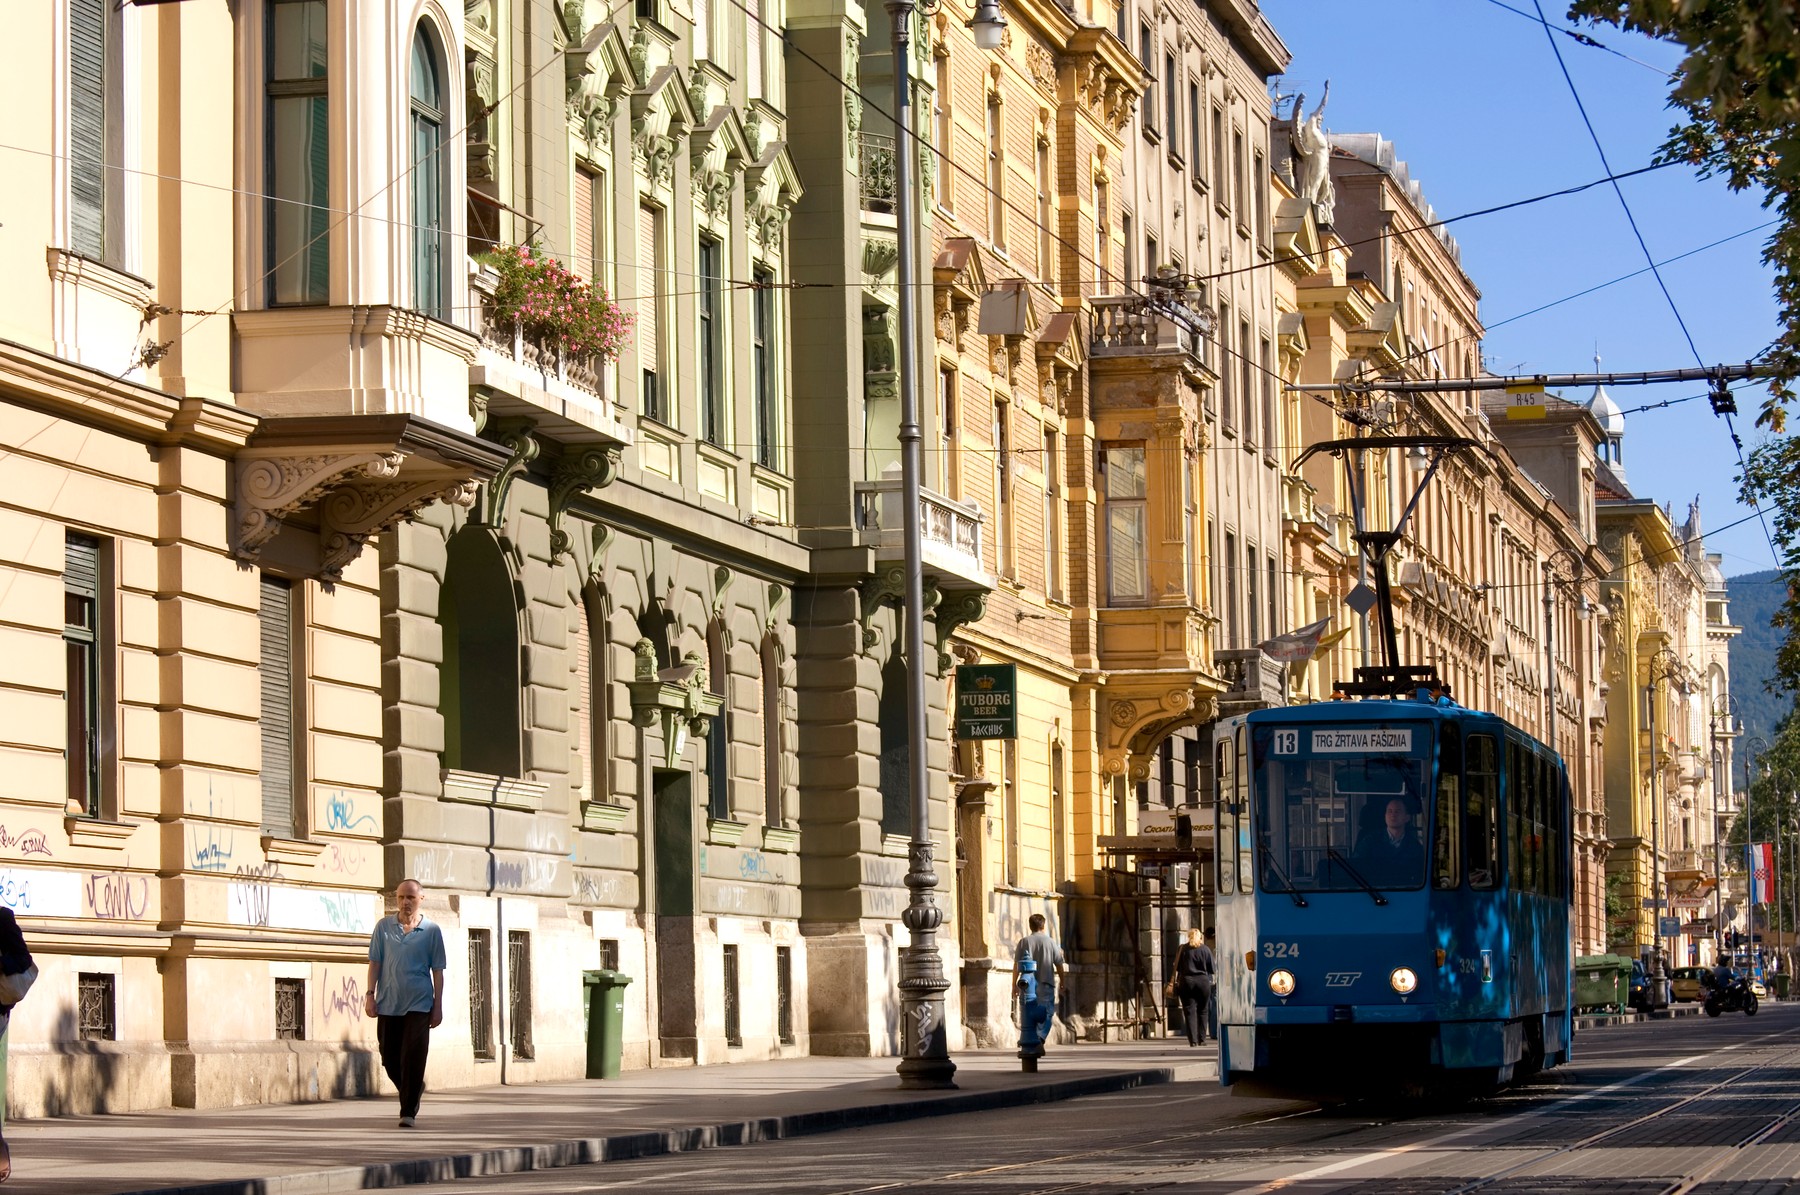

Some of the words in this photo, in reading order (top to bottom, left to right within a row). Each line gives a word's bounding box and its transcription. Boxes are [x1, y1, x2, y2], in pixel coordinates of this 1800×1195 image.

[960, 693, 1011, 706] TUBORG
[973, 706, 998, 715] BEER
[971, 724, 1003, 736] BACCHUS
[1277, 732, 1296, 753] 13
[1315, 734, 1333, 748] TRG
[1335, 731, 1368, 748] ŽRTAVA
[1370, 730, 1407, 747] FAŠIZMA
[1263, 942, 1300, 958] 324
[1459, 958, 1476, 973] 324
[1325, 971, 1362, 987] ZET
